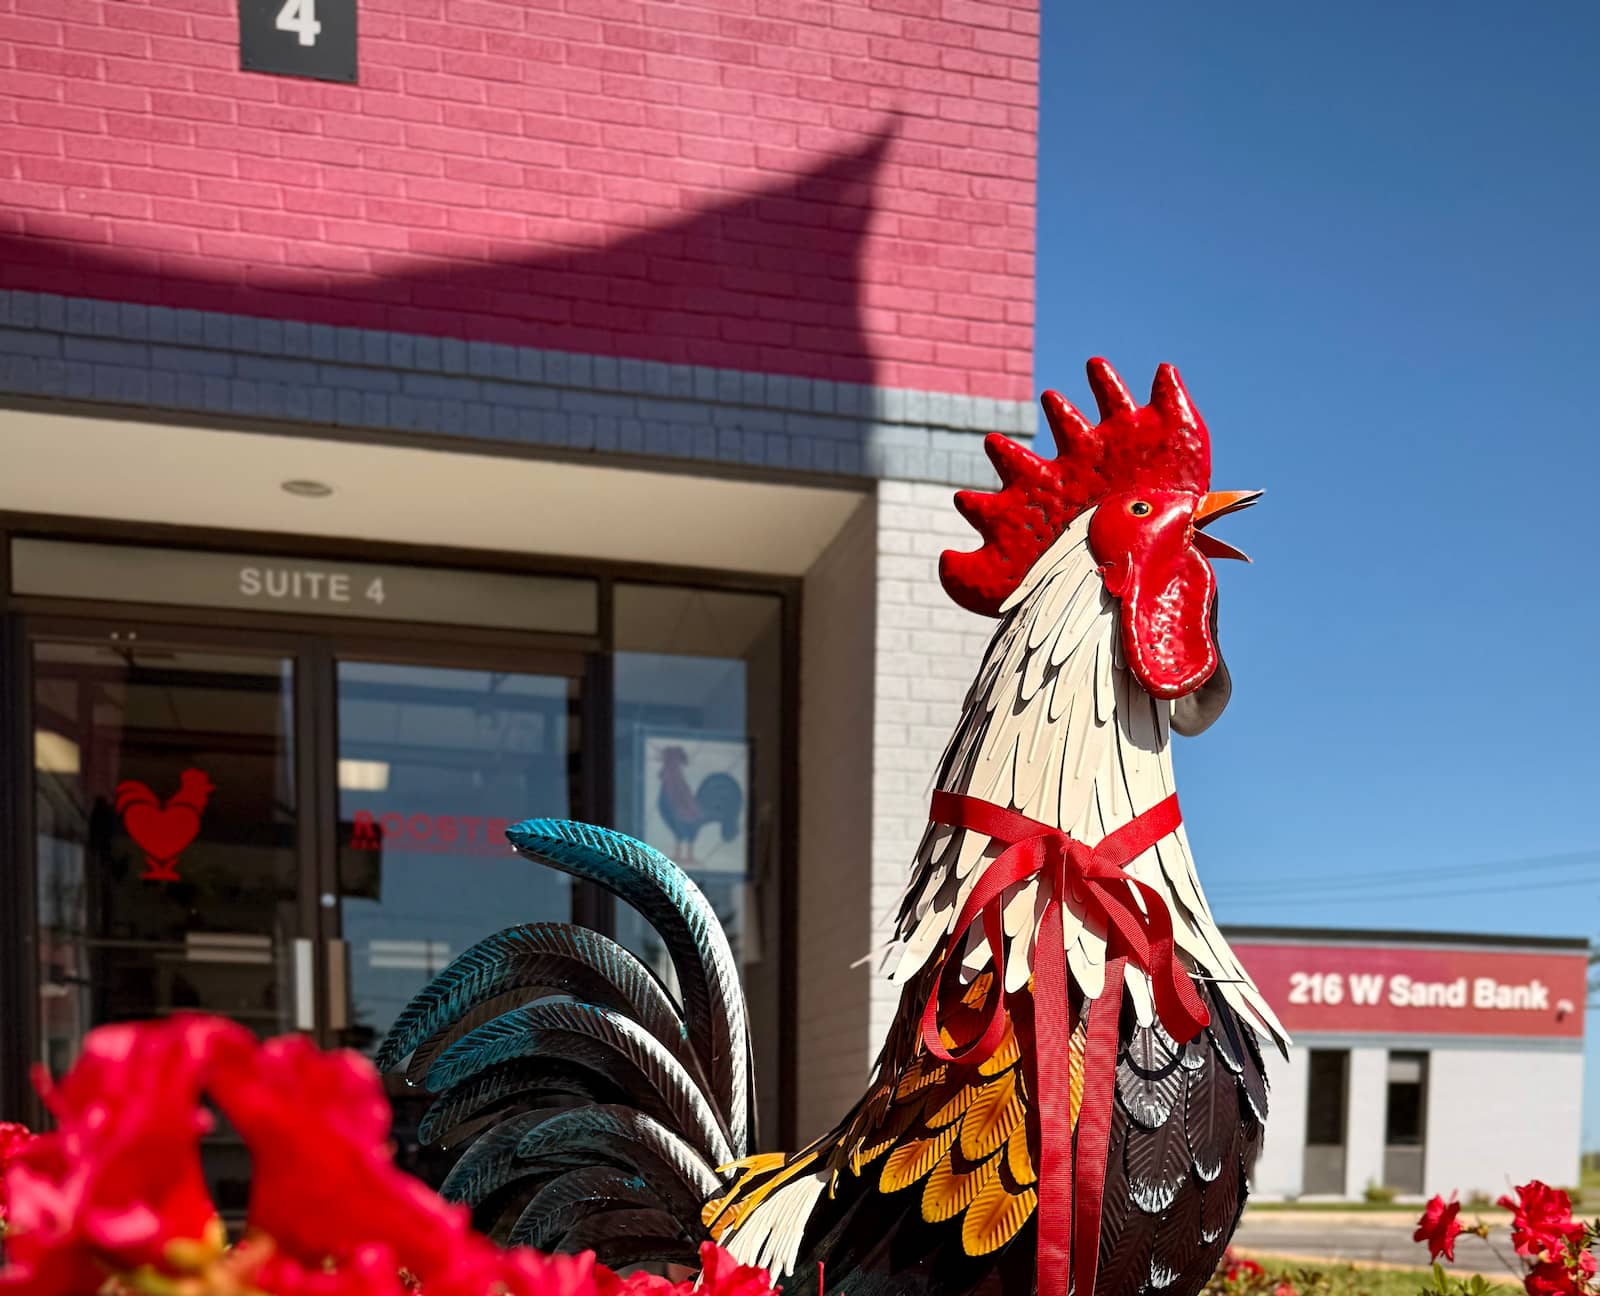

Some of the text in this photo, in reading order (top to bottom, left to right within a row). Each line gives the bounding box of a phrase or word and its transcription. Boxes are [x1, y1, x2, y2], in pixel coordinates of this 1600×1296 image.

[276, 0, 321, 47] 4
[239, 567, 386, 605] SUITE 4
[353, 809, 513, 846] ROOSTE
[1288, 972, 1549, 1010] 216 W Sand Bank
